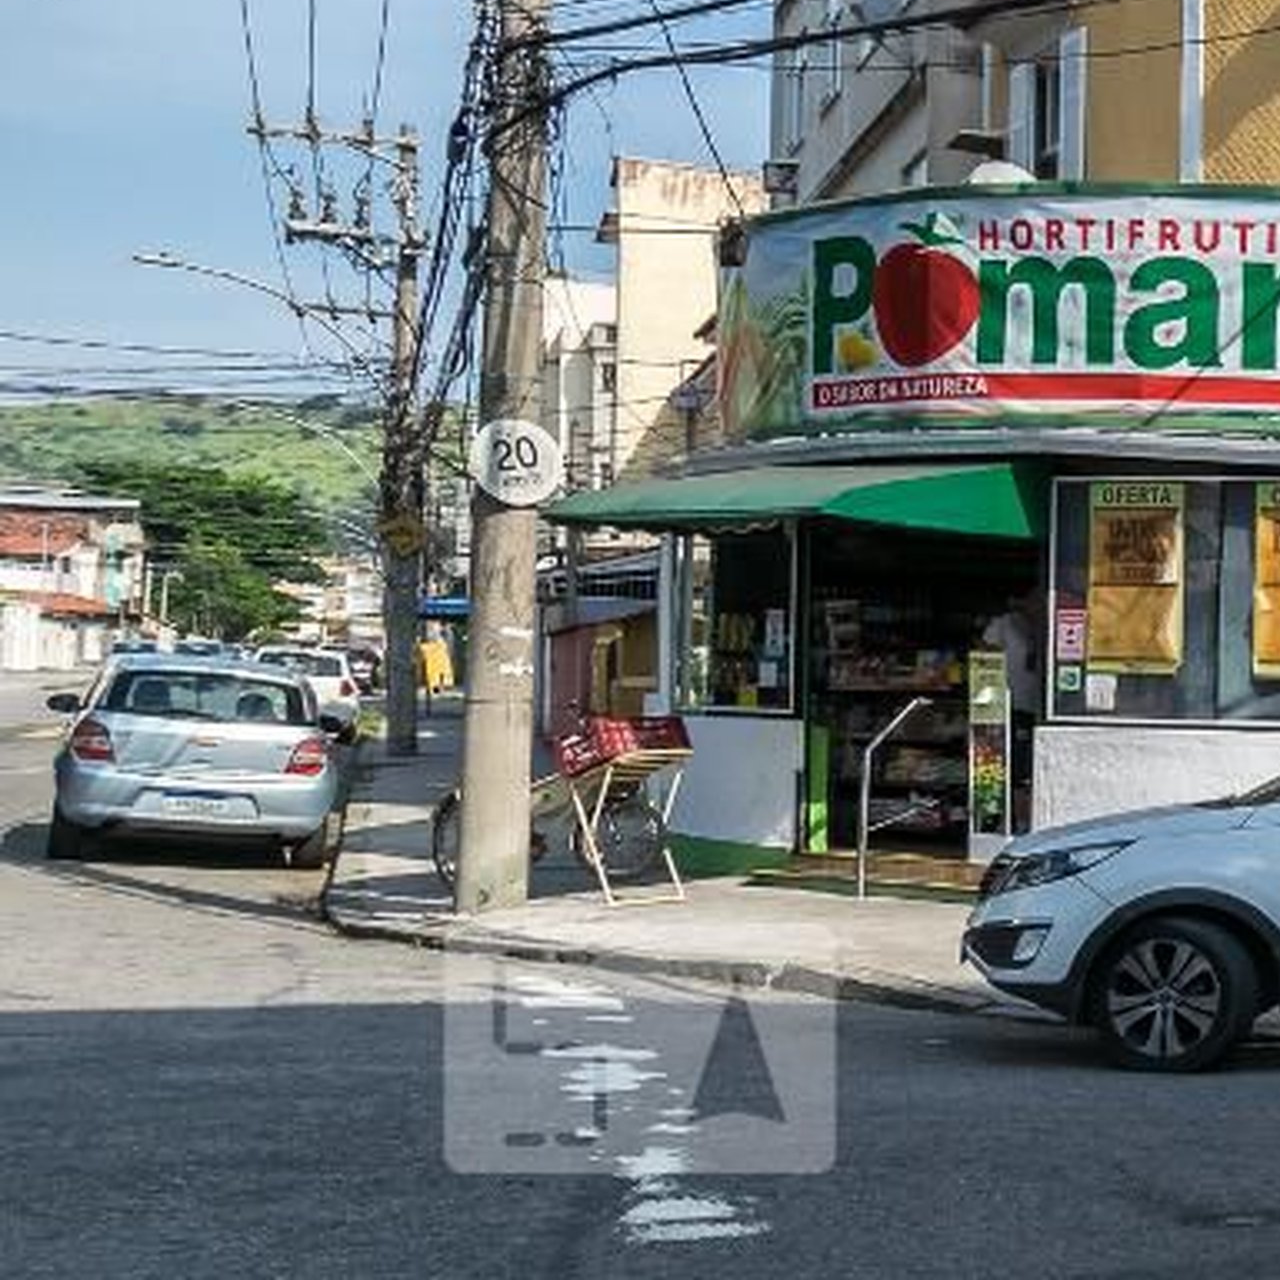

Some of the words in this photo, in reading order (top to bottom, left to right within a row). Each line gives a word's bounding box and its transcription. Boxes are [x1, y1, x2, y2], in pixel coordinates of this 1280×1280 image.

[978, 219, 1278, 255] HORTIFRUTI
[901, 375, 989, 398] NATUREZA
[493, 436, 538, 471] 20
[1102, 485, 1172, 504] OFERTA
